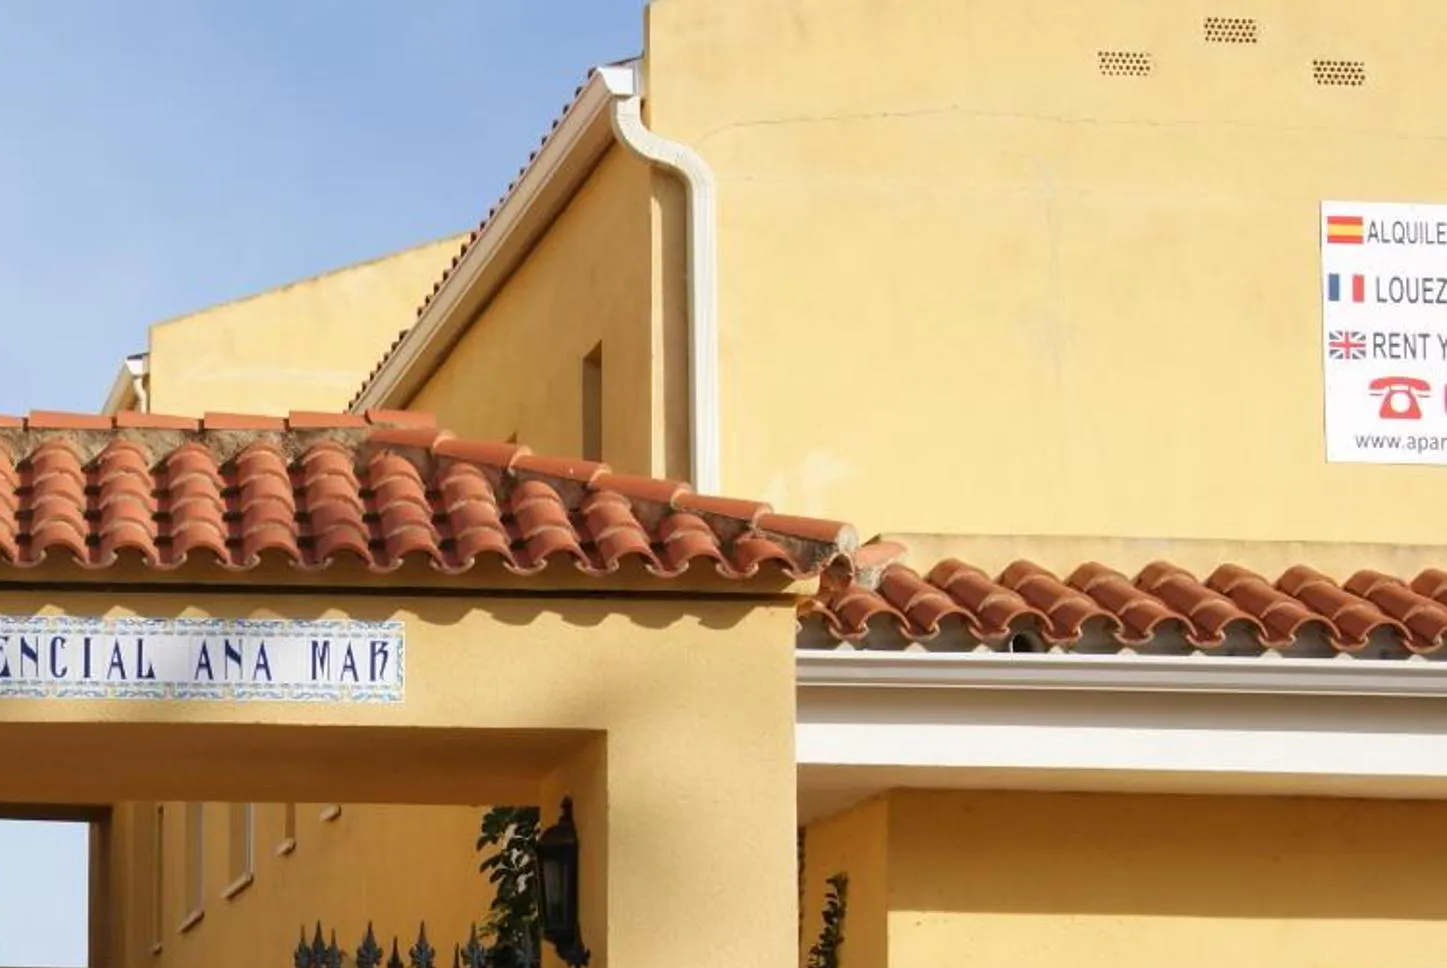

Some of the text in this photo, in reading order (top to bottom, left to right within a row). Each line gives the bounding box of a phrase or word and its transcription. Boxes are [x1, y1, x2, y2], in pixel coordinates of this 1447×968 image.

[1376, 275, 1447, 304] LOUEZ
[1373, 332, 1431, 360] RENT
[194, 637, 273, 682] ANA
[311, 639, 391, 683] MAR
